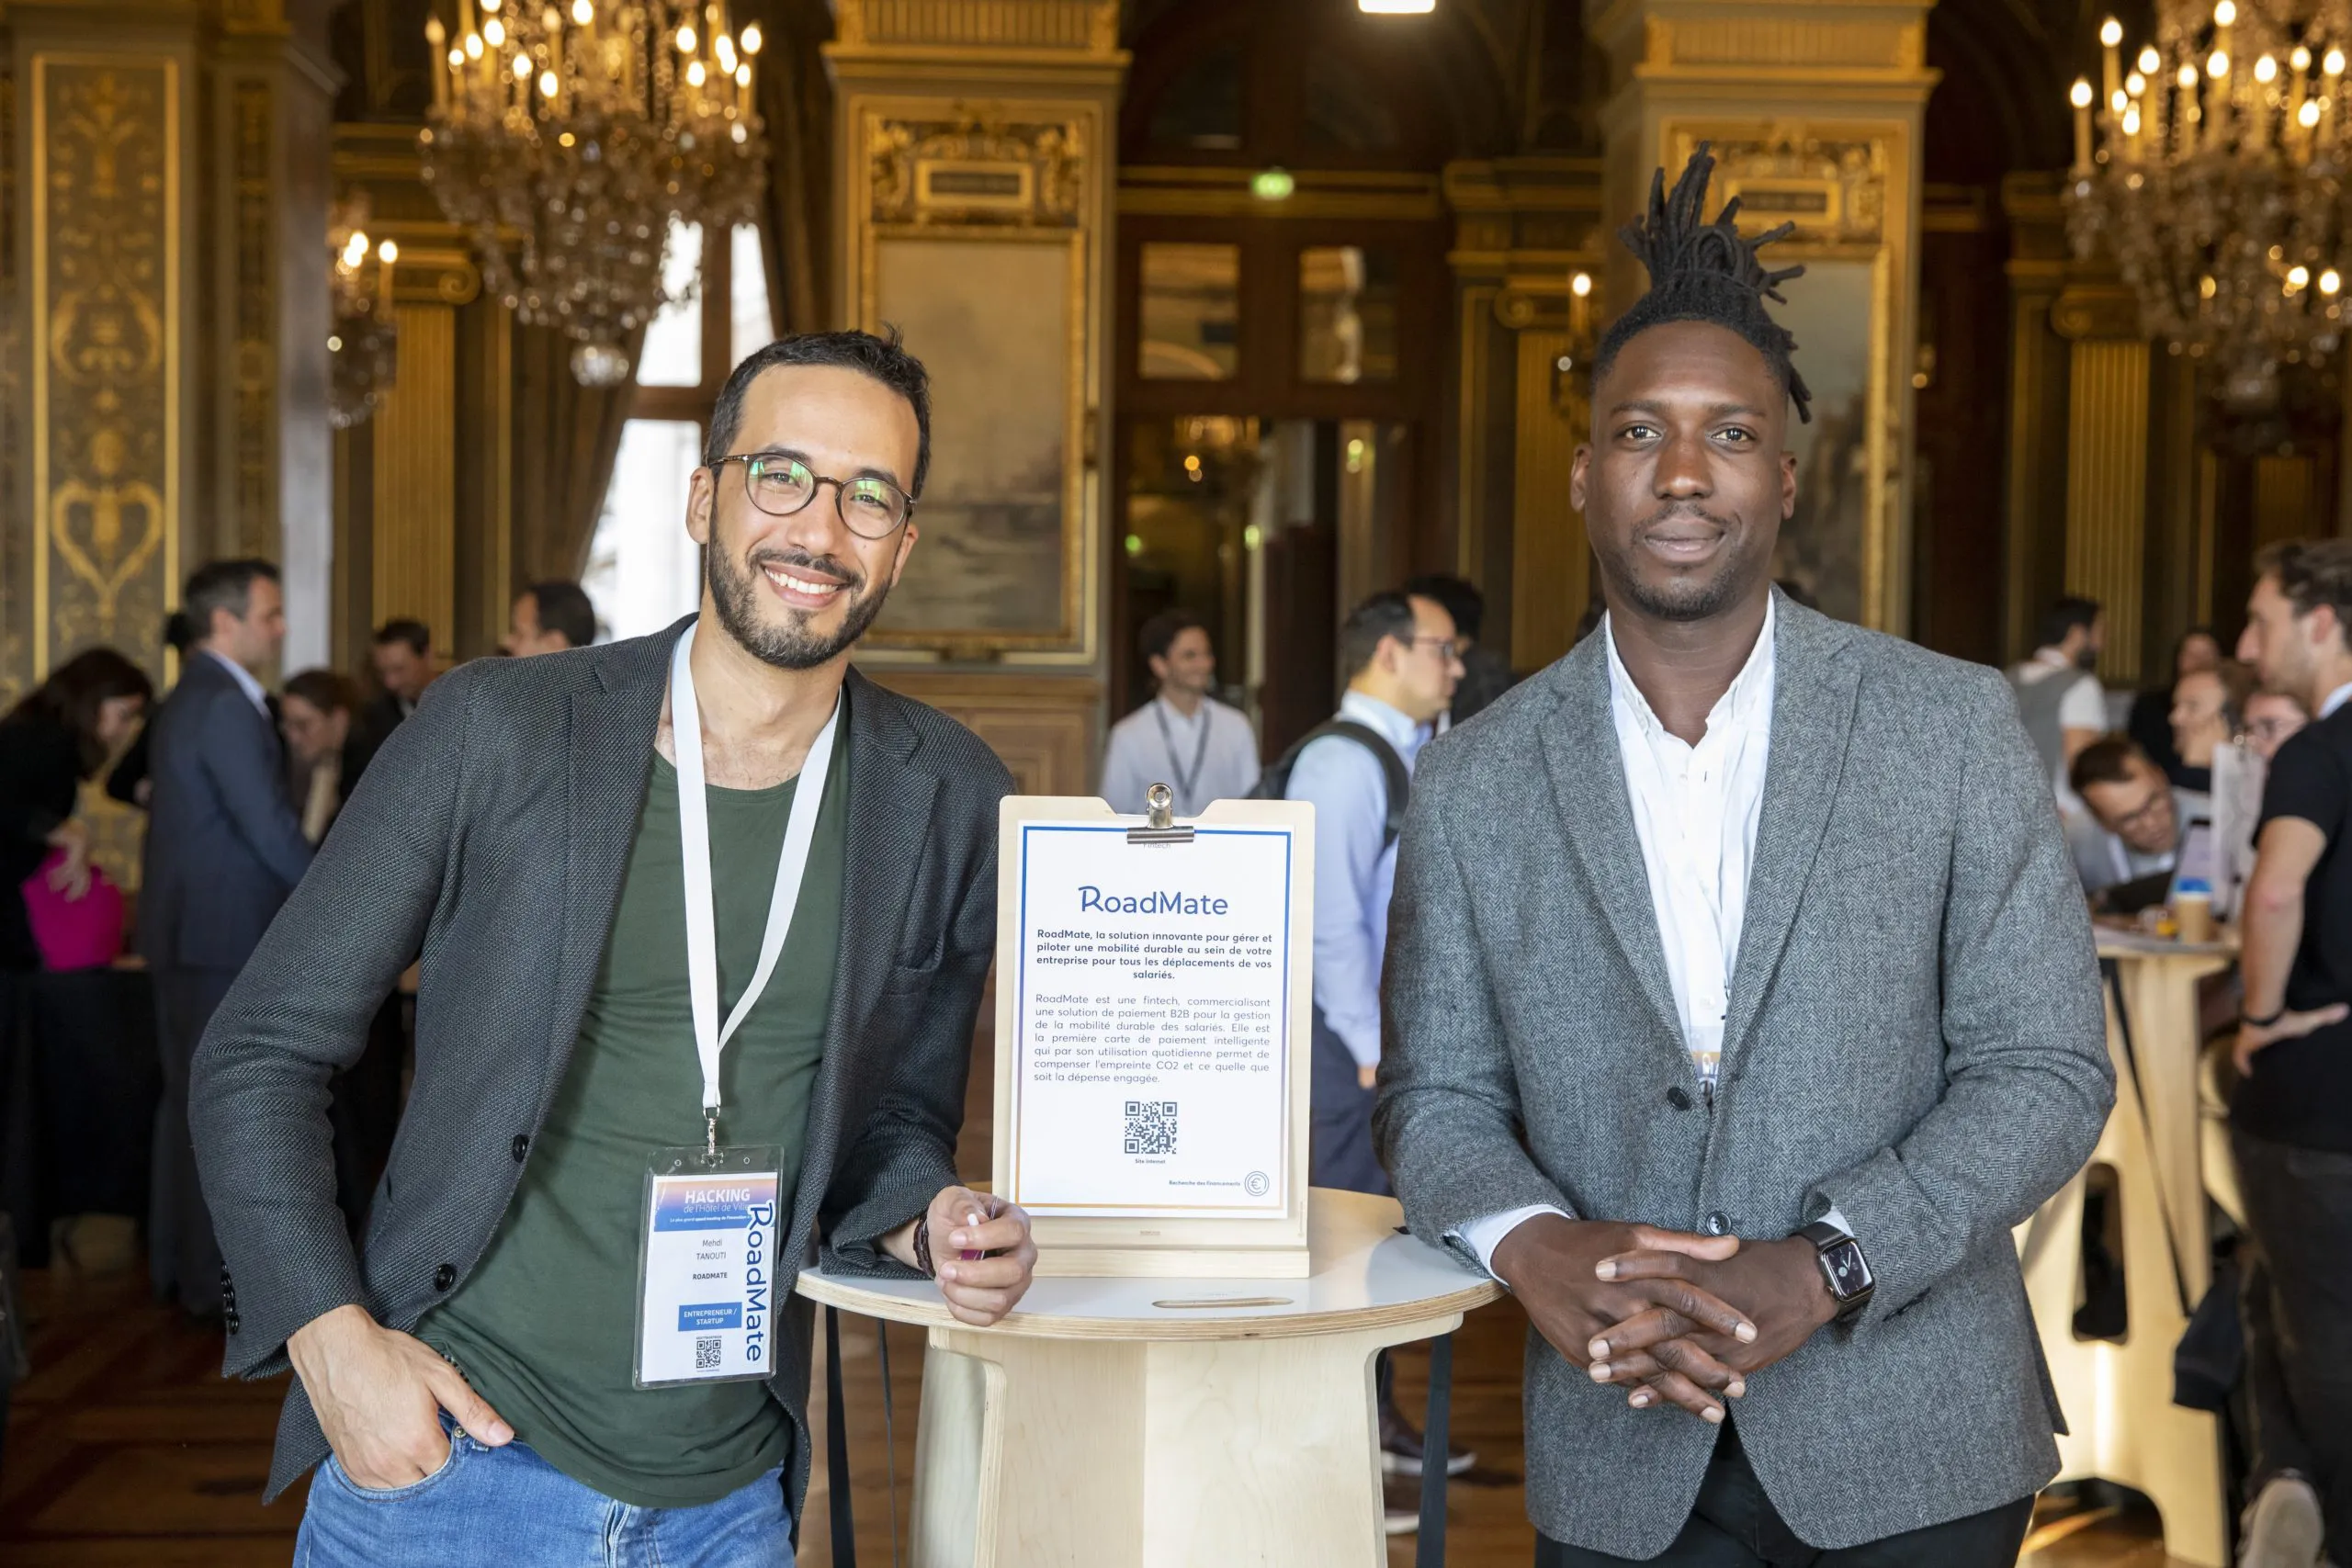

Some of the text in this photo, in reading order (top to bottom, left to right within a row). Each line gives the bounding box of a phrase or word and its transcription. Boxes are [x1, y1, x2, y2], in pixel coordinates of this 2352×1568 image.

[1079, 886, 1227, 915] RoadMate
[1038, 930, 1092, 940] RoadMate,
[1109, 931, 1148, 940] solution
[1233, 933, 1259, 943] gérer
[1037, 942, 1070, 953] piloter
[1098, 943, 1139, 953] mobilité
[1144, 944, 1182, 953] durable
[1229, 946, 1241, 954] de
[1037, 956, 1088, 965] entreprise
[1120, 957, 1140, 965] tous
[1146, 957, 1159, 965] les
[1162, 958, 1234, 968] déplacements
[1238, 959, 1250, 967] de
[1133, 970, 1174, 978] salariés.
[1036, 994, 1088, 1003] RoadMate
[1143, 996, 1180, 1006] fintech,
[1188, 998, 1270, 1007] commercialisant
[1058, 1008, 1097, 1017] solution
[1102, 1009, 1114, 1017] de
[1118, 1009, 1165, 1019] paiement
[1170, 1010, 1189, 1018] B2B
[1221, 1010, 1229, 1019] la
[1234, 1011, 1270, 1021] gestion
[1035, 1021, 1047, 1029] de
[1055, 1021, 1063, 1029] la
[1069, 1021, 1110, 1030] mobilité
[1116, 1021, 1155, 1031] durable
[1161, 1021, 1179, 1031] des
[1185, 1021, 1225, 1032] salariés.
[1232, 1023, 1249, 1032] Elle
[1035, 1033, 1044, 1042] la
[1052, 1034, 1096, 1043] première
[1138, 1034, 1150, 1043] de
[1159, 1036, 1205, 1045] paiement
[1215, 1036, 1270, 1047] intelligente
[1035, 1047, 1049, 1056] qui
[1099, 1047, 1147, 1056] utilisation
[1152, 1048, 1212, 1058] quotidienne
[1216, 1051, 1252, 1059] permet
[1257, 1050, 1269, 1058] de
[1035, 1061, 1091, 1069] compenser
[1096, 1060, 1151, 1071] l'empreinte
[1157, 1061, 1178, 1070] CO2
[1183, 1062, 1193, 1070] et
[1216, 1062, 1245, 1072] quelle
[1250, 1065, 1269, 1073] que
[1056, 1073, 1064, 1081] la
[1068, 1073, 1110, 1083] dépense
[1114, 1073, 1159, 1084] engagée.
[684, 1188, 751, 1203] HACKING
[684, 1204, 694, 1213] de
[695, 1202, 720, 1213] l'Hôtel
[721, 1202, 732, 1212] de
[696, 1252, 726, 1260] TANOUTI
[746, 1202, 773, 1362] RoadMate
[684, 1309, 732, 1317] ENTREPRENEUR
